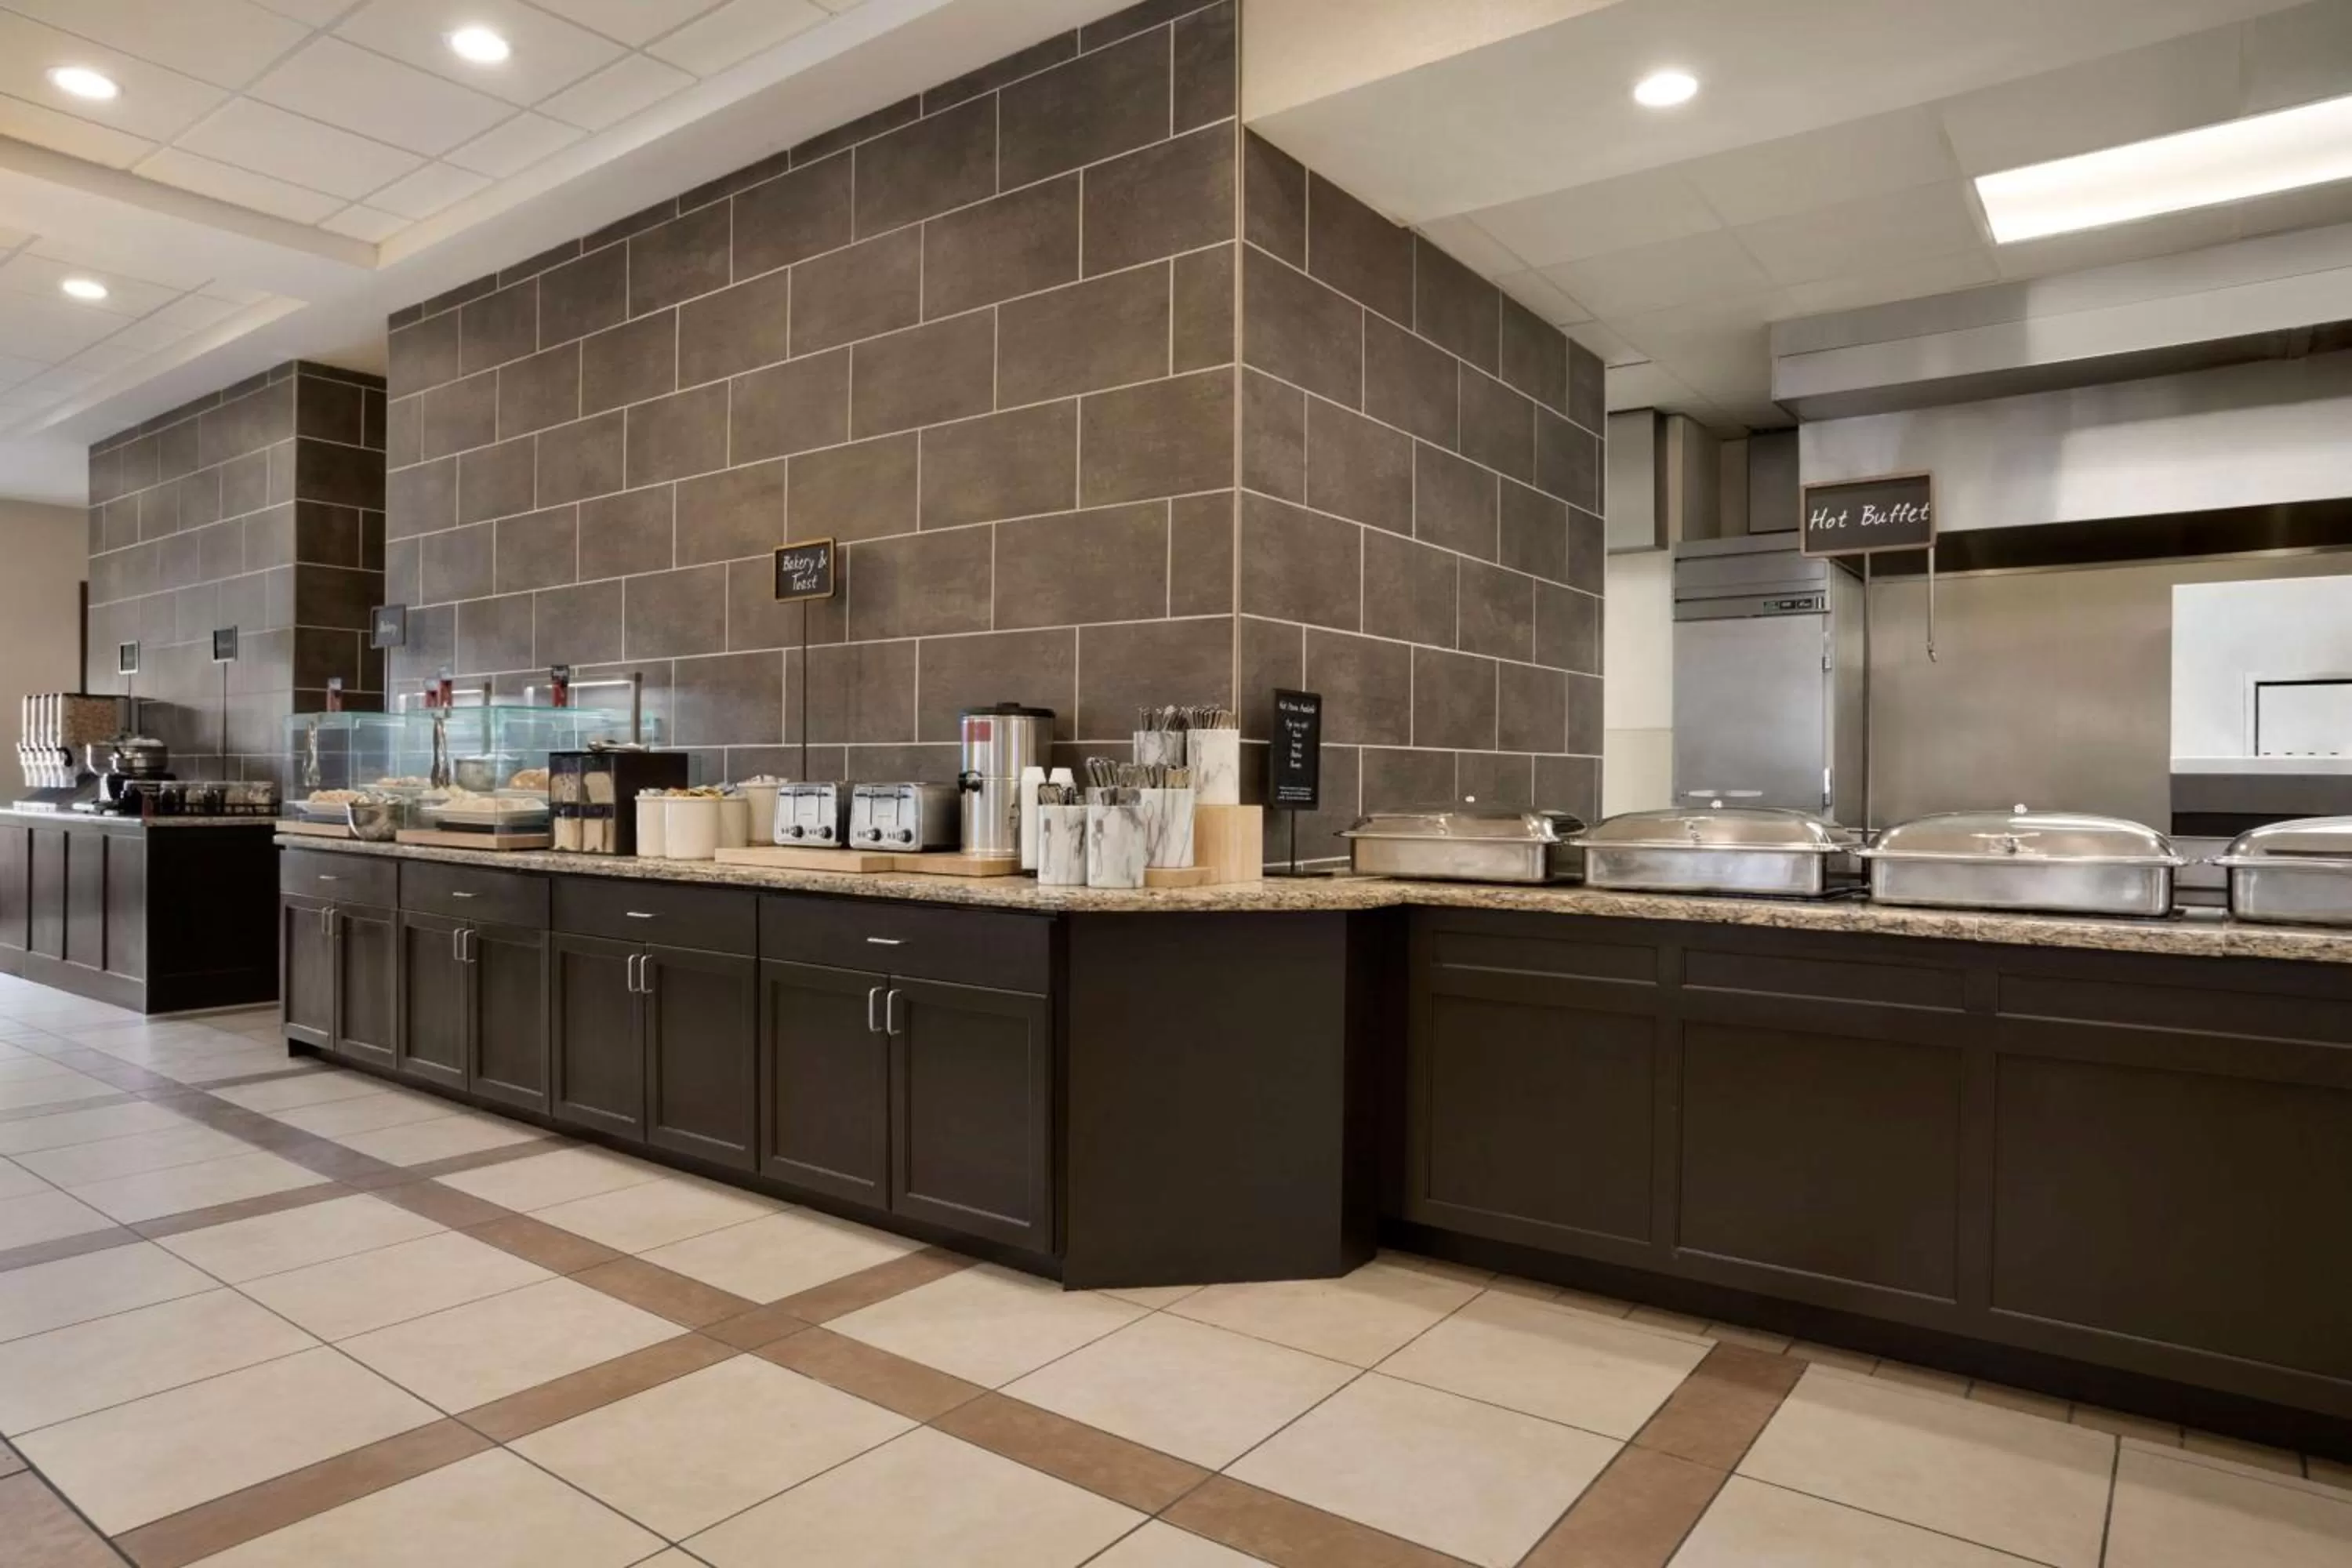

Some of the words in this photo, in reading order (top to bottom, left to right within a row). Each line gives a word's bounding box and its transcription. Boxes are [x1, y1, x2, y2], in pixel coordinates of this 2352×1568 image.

[1809, 507, 1849, 532] Hot
[1860, 501, 1931, 527] Buffet
[782, 554, 815, 575] Bakery
